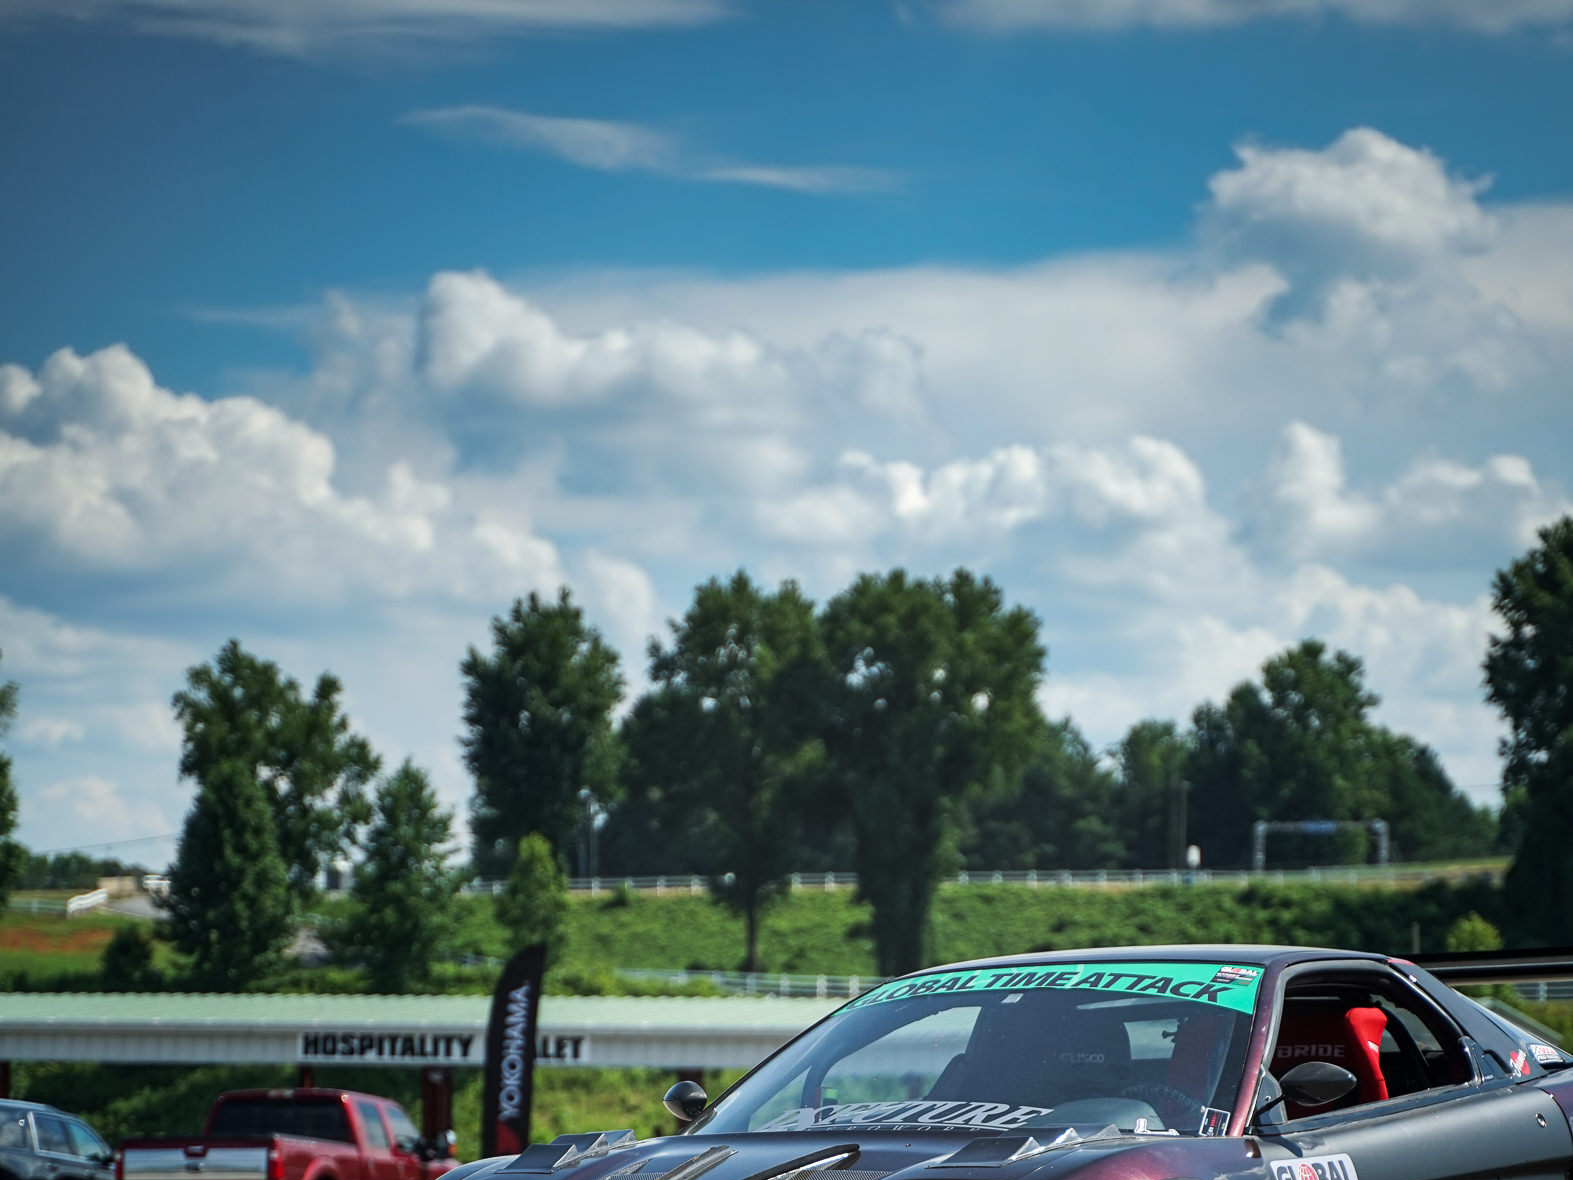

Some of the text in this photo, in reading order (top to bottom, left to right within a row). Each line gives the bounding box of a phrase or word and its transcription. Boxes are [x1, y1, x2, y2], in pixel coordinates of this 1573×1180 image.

[846, 970, 1236, 1010] GLOBAL TIME ATTACK
[302, 1032, 586, 1058] HOSPITALITY LET
[498, 979, 531, 1119] YOKOHAMA
[1277, 1043, 1346, 1058] BRIDE
